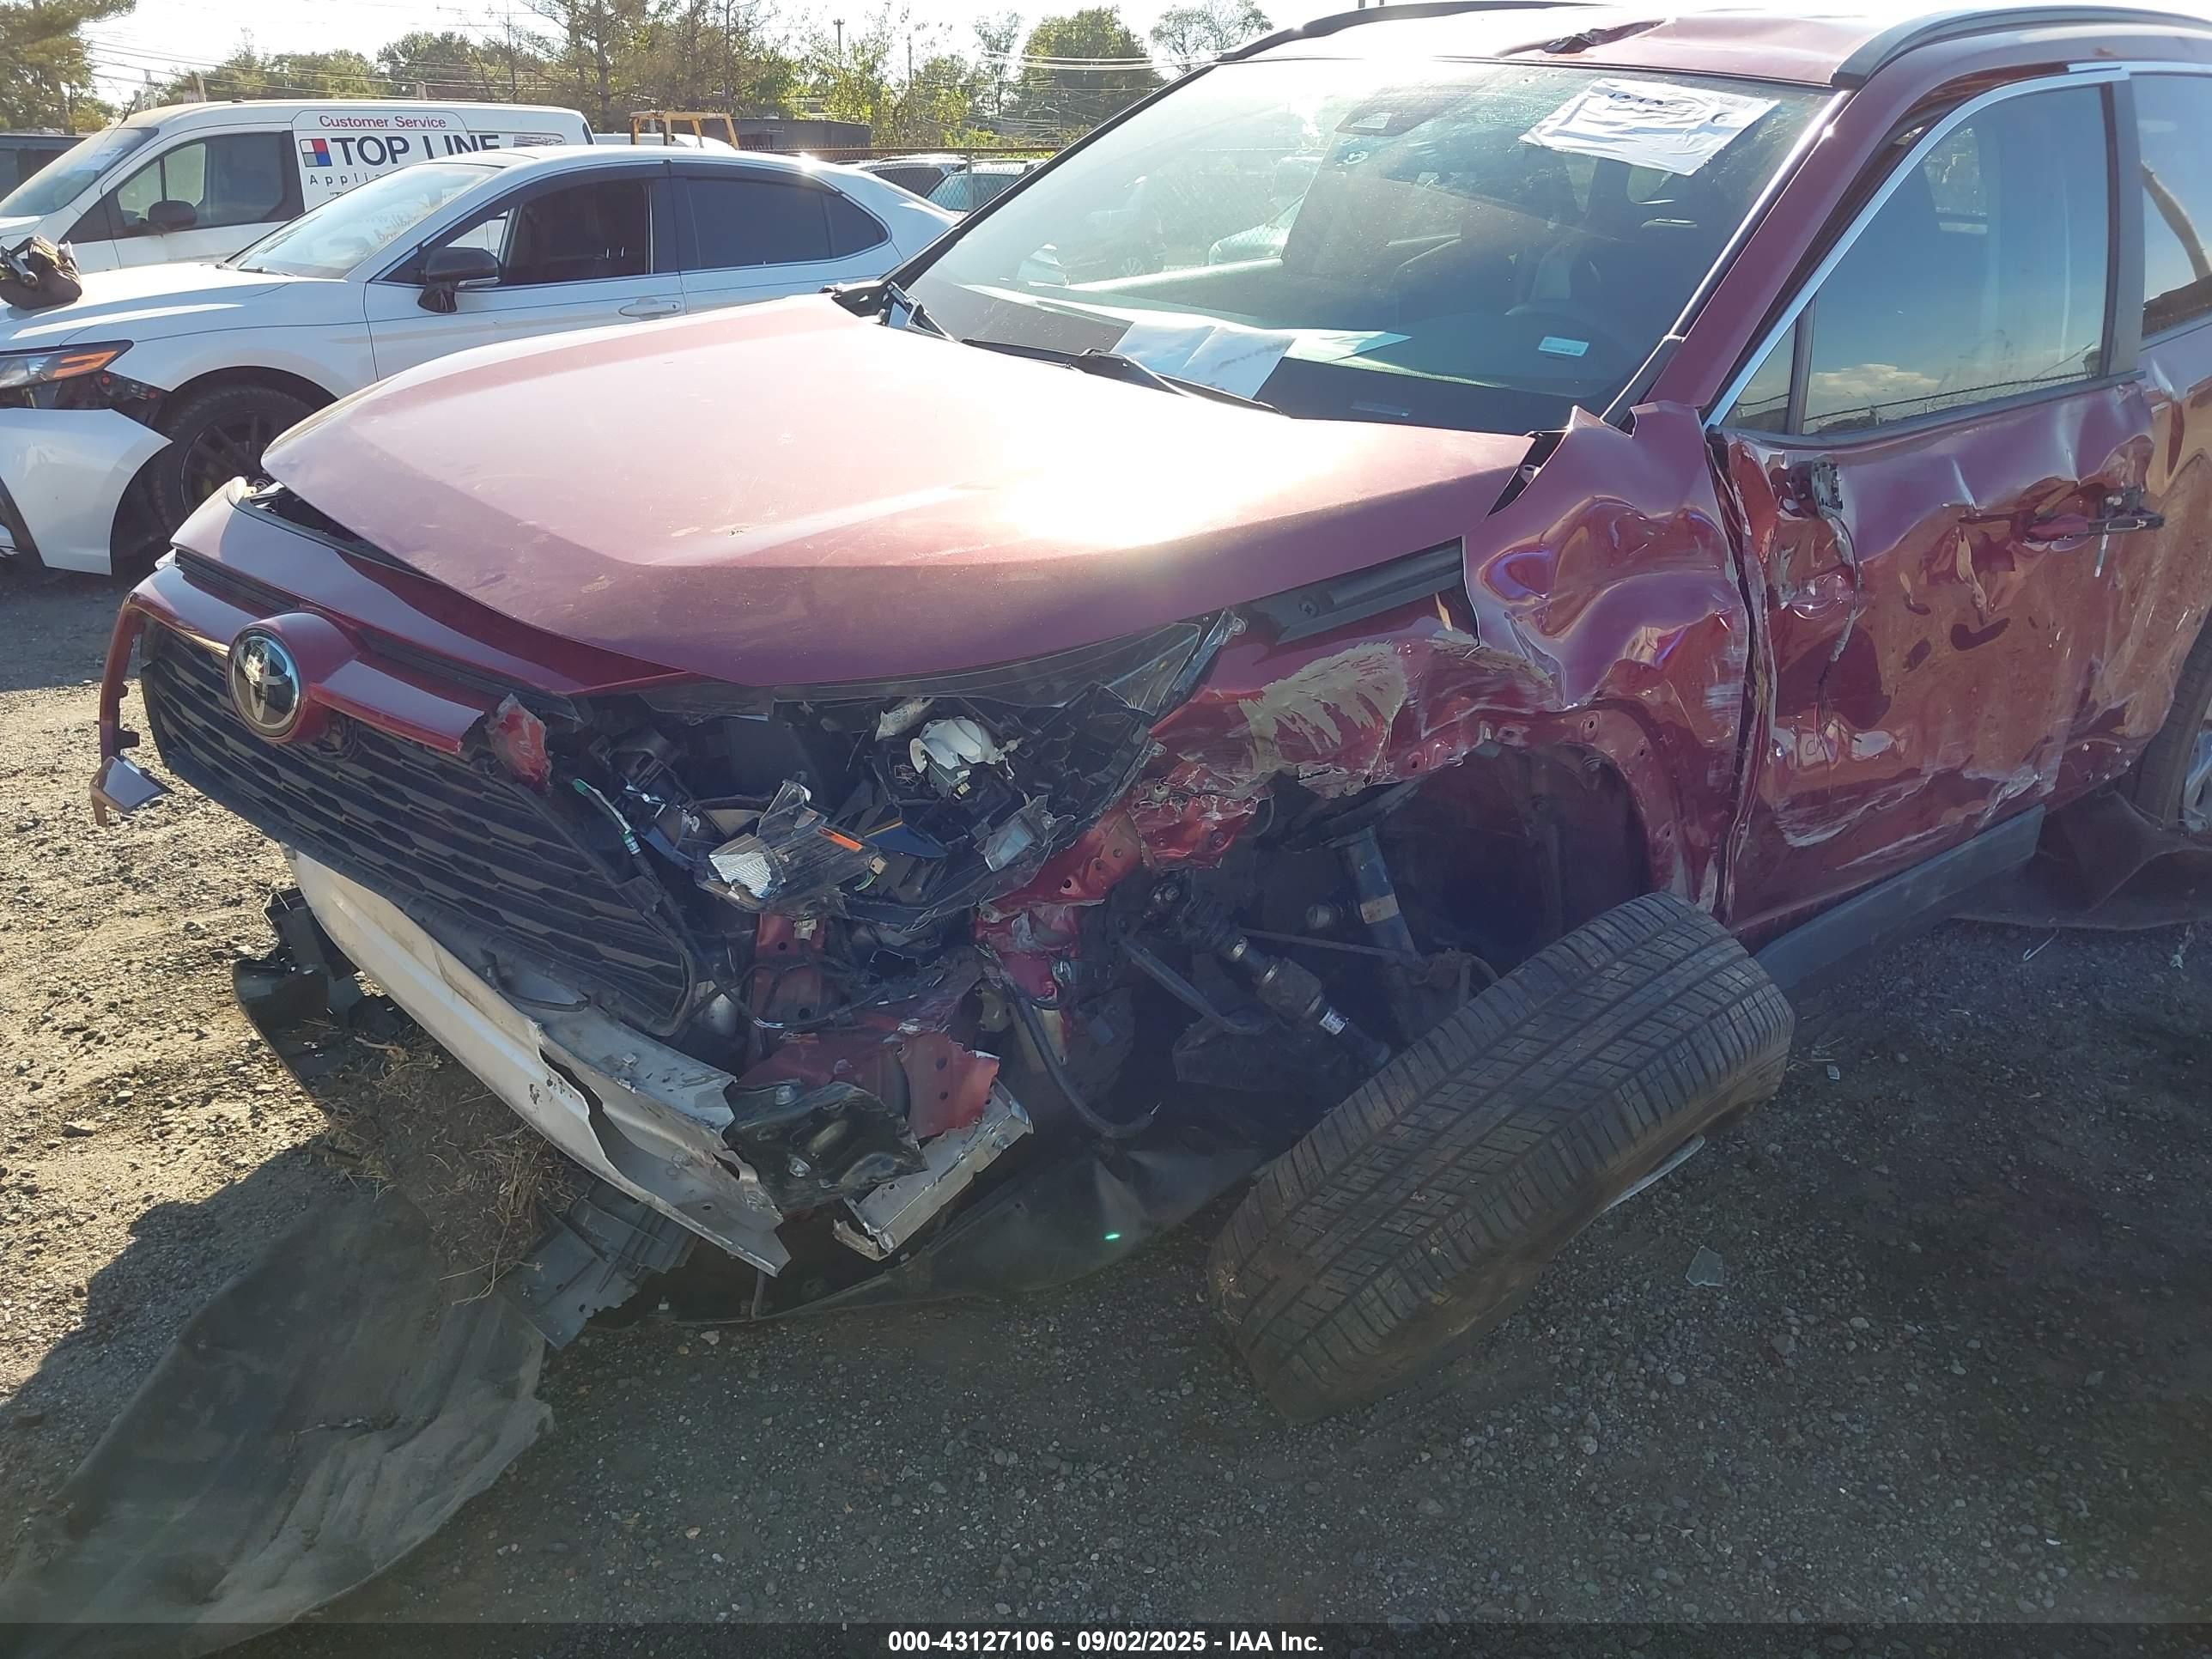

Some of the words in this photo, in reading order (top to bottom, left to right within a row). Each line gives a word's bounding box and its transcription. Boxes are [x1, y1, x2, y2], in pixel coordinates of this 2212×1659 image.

[319, 115, 389, 128] Customer
[394, 116, 447, 128] Service
[331, 136, 410, 167] TOP
